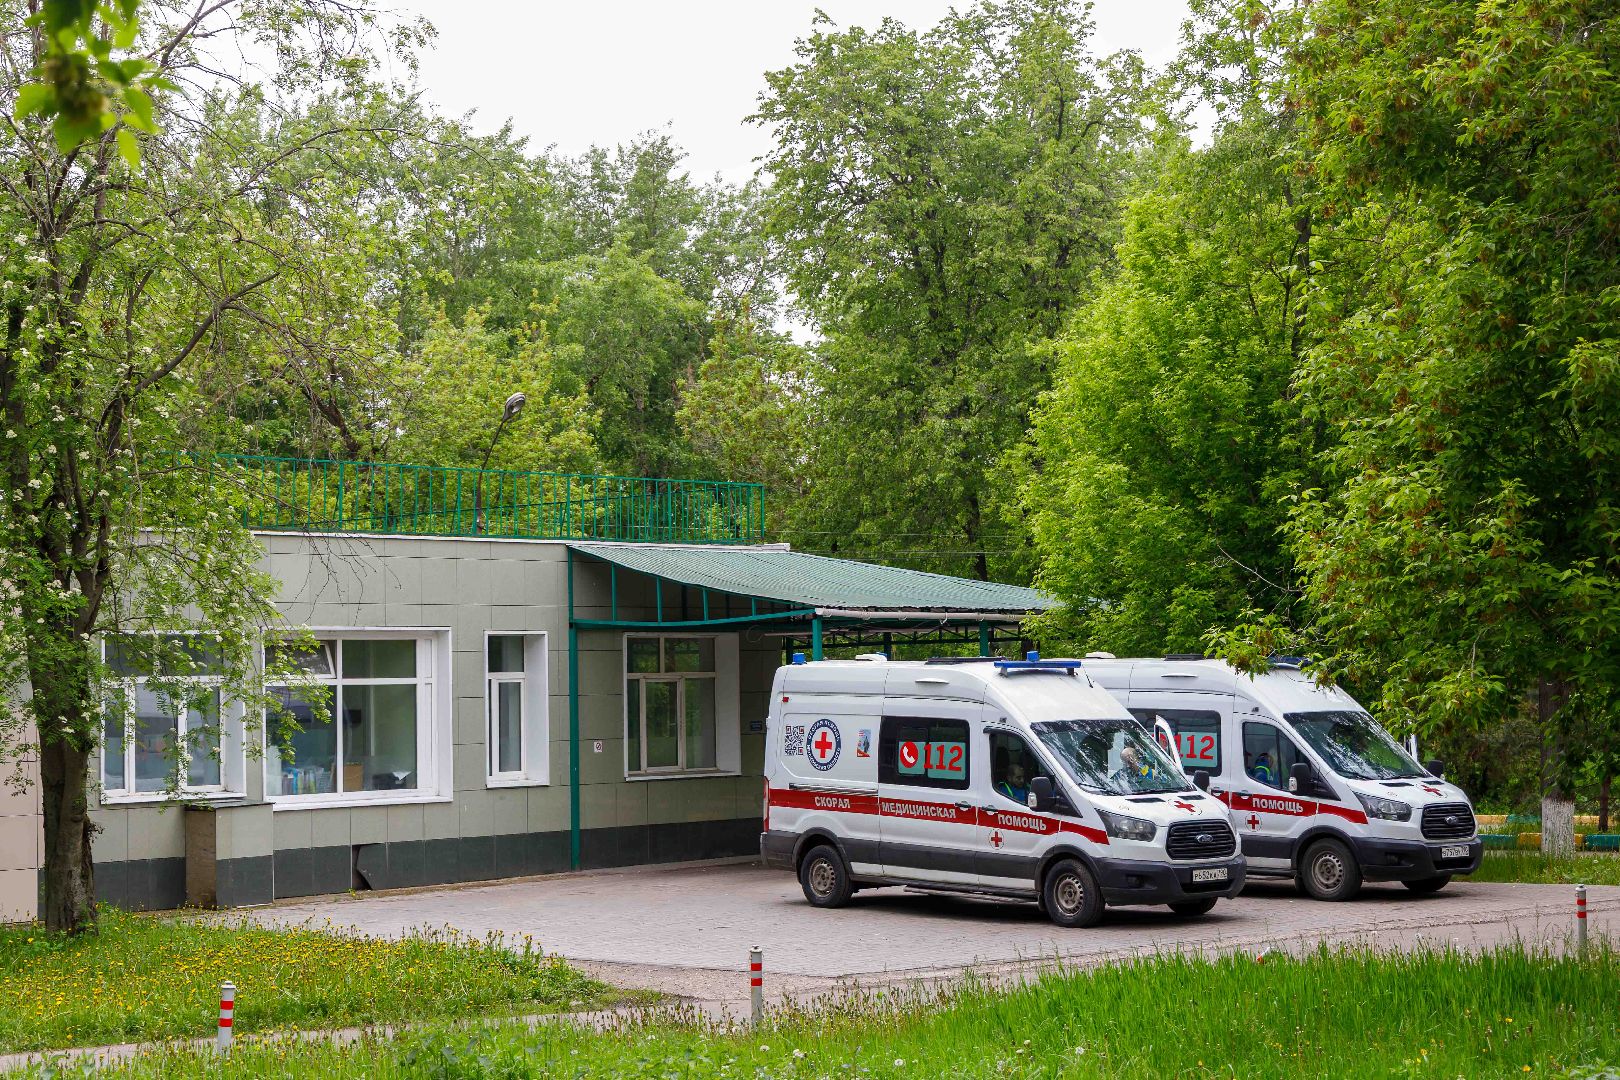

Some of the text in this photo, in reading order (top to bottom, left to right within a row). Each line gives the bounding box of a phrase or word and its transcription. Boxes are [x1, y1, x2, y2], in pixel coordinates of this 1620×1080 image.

[924, 744, 963, 772] 112
[814, 796, 1047, 831] СКОРАЯ МЕДИЦИНСКАЯ ПОМОЩЬ
[1252, 797, 1304, 813] ПОМОЩЬ
